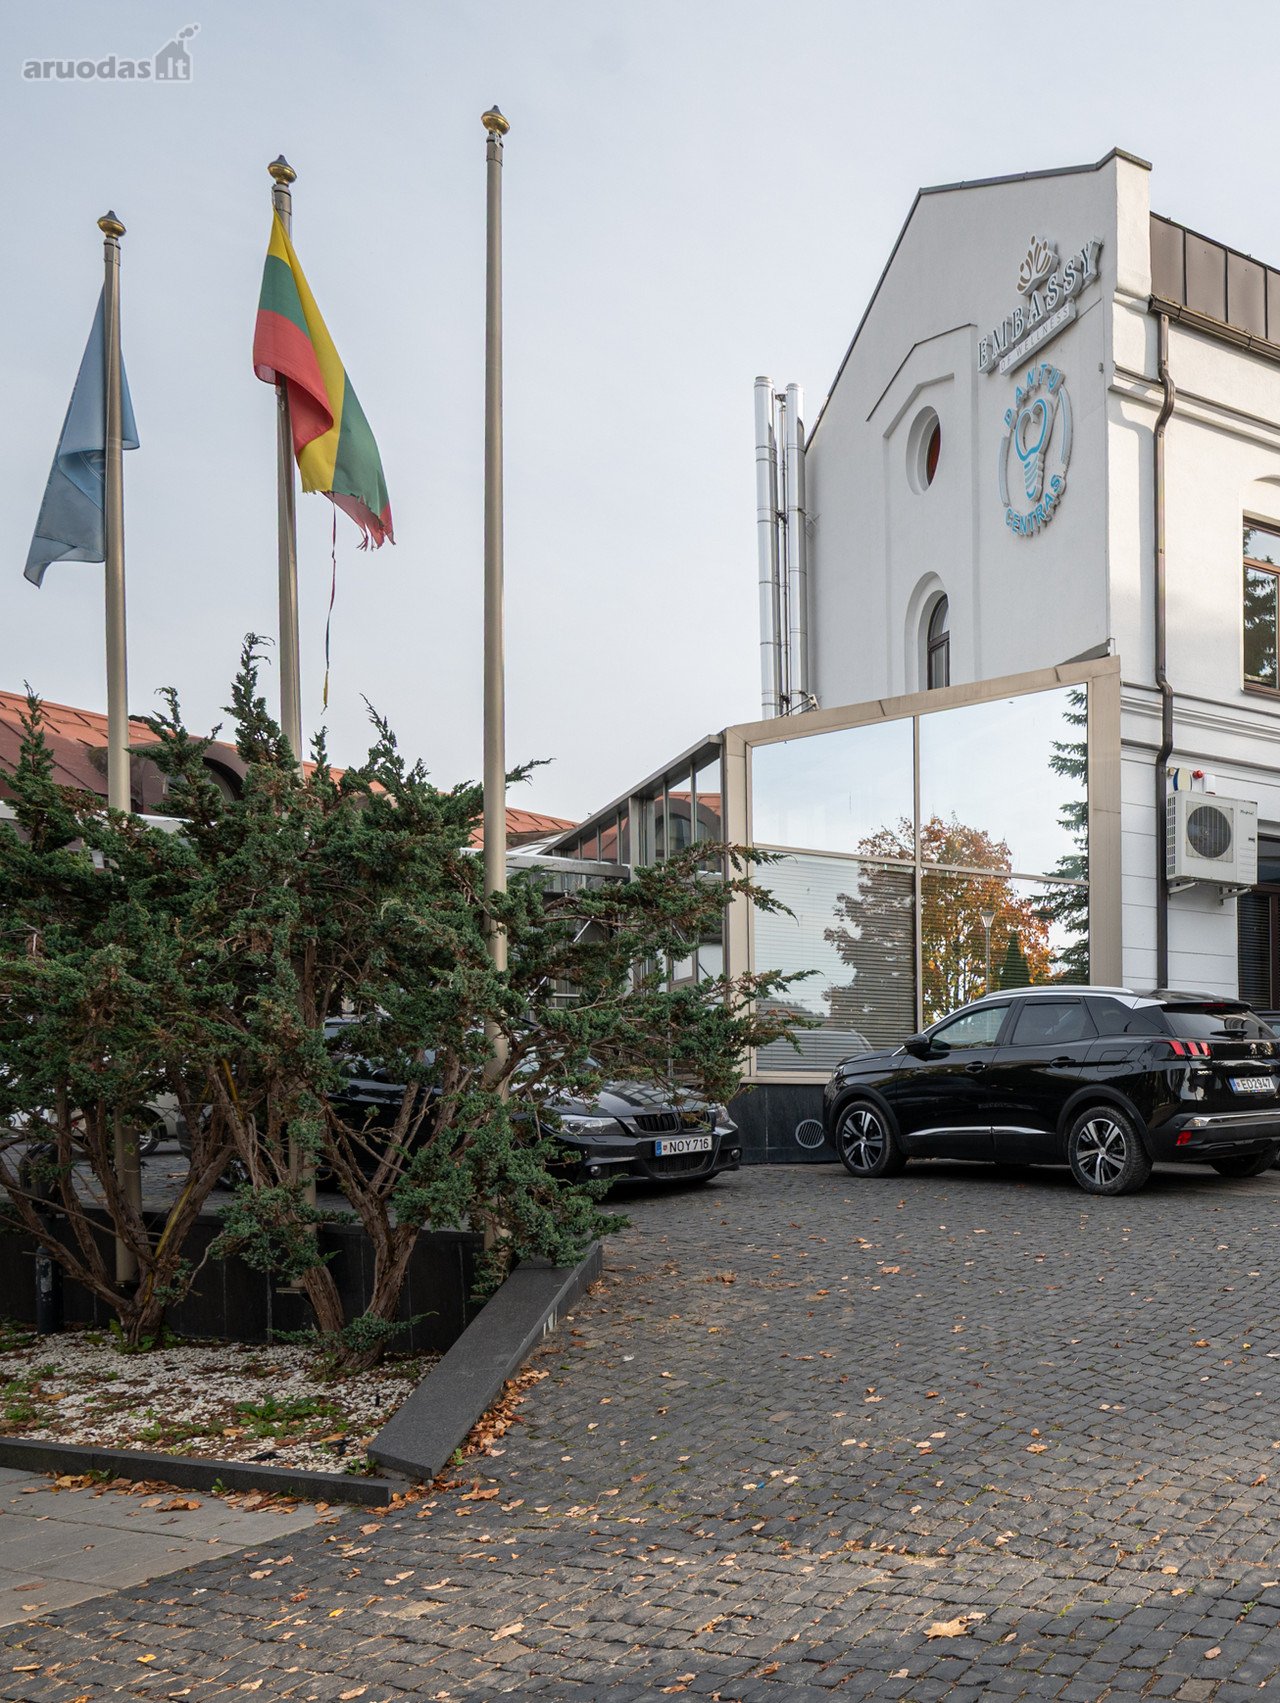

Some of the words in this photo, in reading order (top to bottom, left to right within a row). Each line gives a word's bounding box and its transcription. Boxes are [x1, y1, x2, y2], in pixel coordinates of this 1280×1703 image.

[978, 239, 1102, 374] EMBASSY
[1000, 356, 1012, 372] OF
[1015, 304, 1070, 358] WELLNESS
[1005, 474, 1062, 537] CENTRAS
